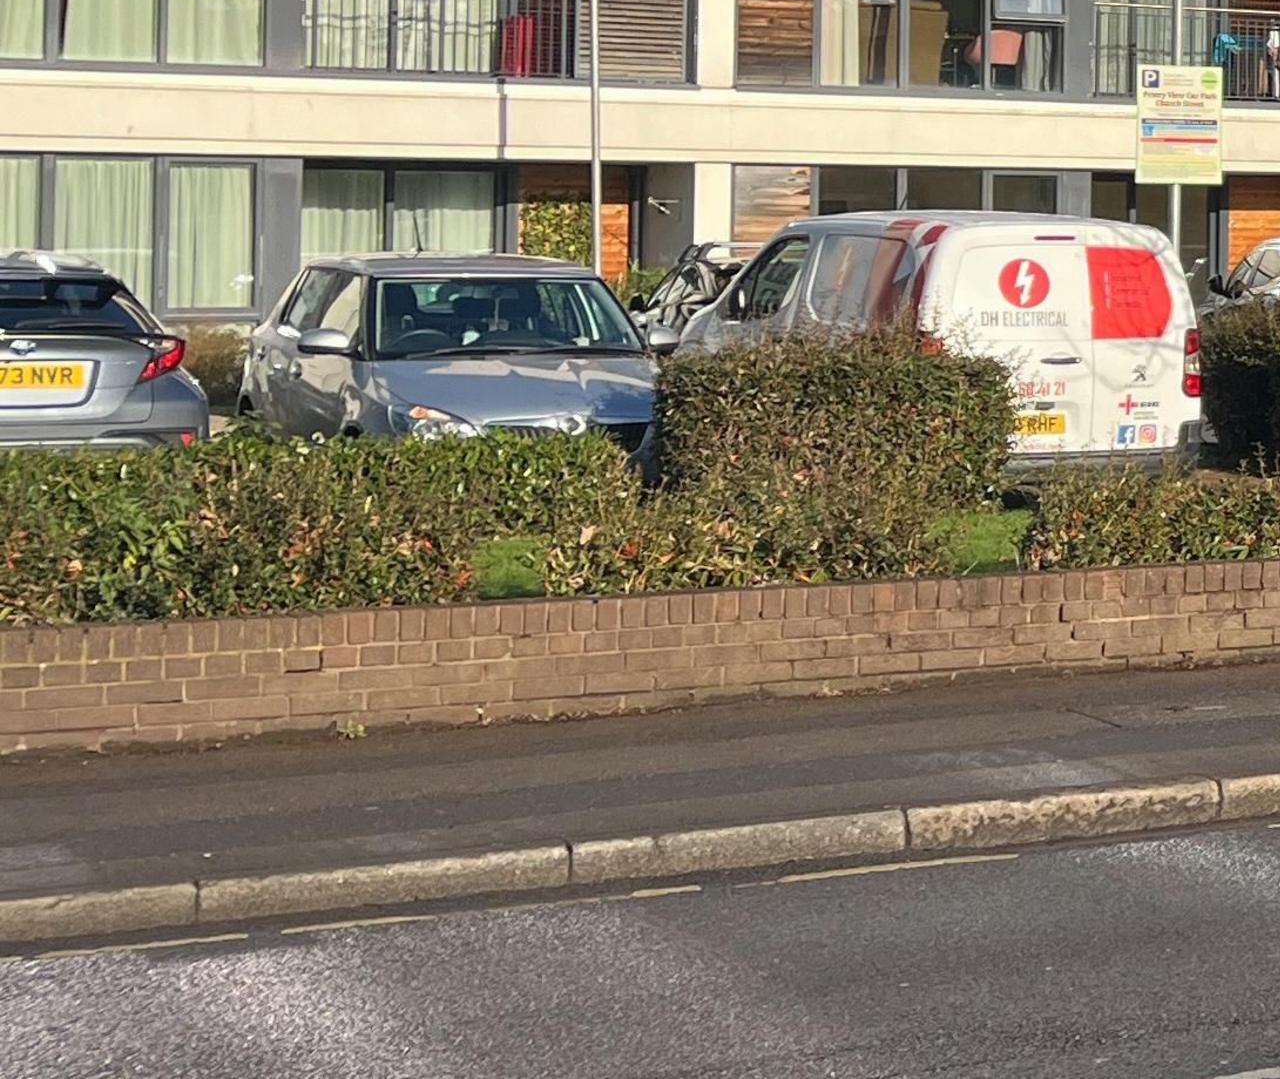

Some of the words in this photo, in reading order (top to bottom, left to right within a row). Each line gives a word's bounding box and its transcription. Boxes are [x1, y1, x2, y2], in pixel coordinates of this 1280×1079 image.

[981, 311, 999, 327] DH
[1003, 311, 1069, 327] ELECTRICAL
[32, 367, 73, 384] NVR
[1054, 381, 1065, 396] 21
